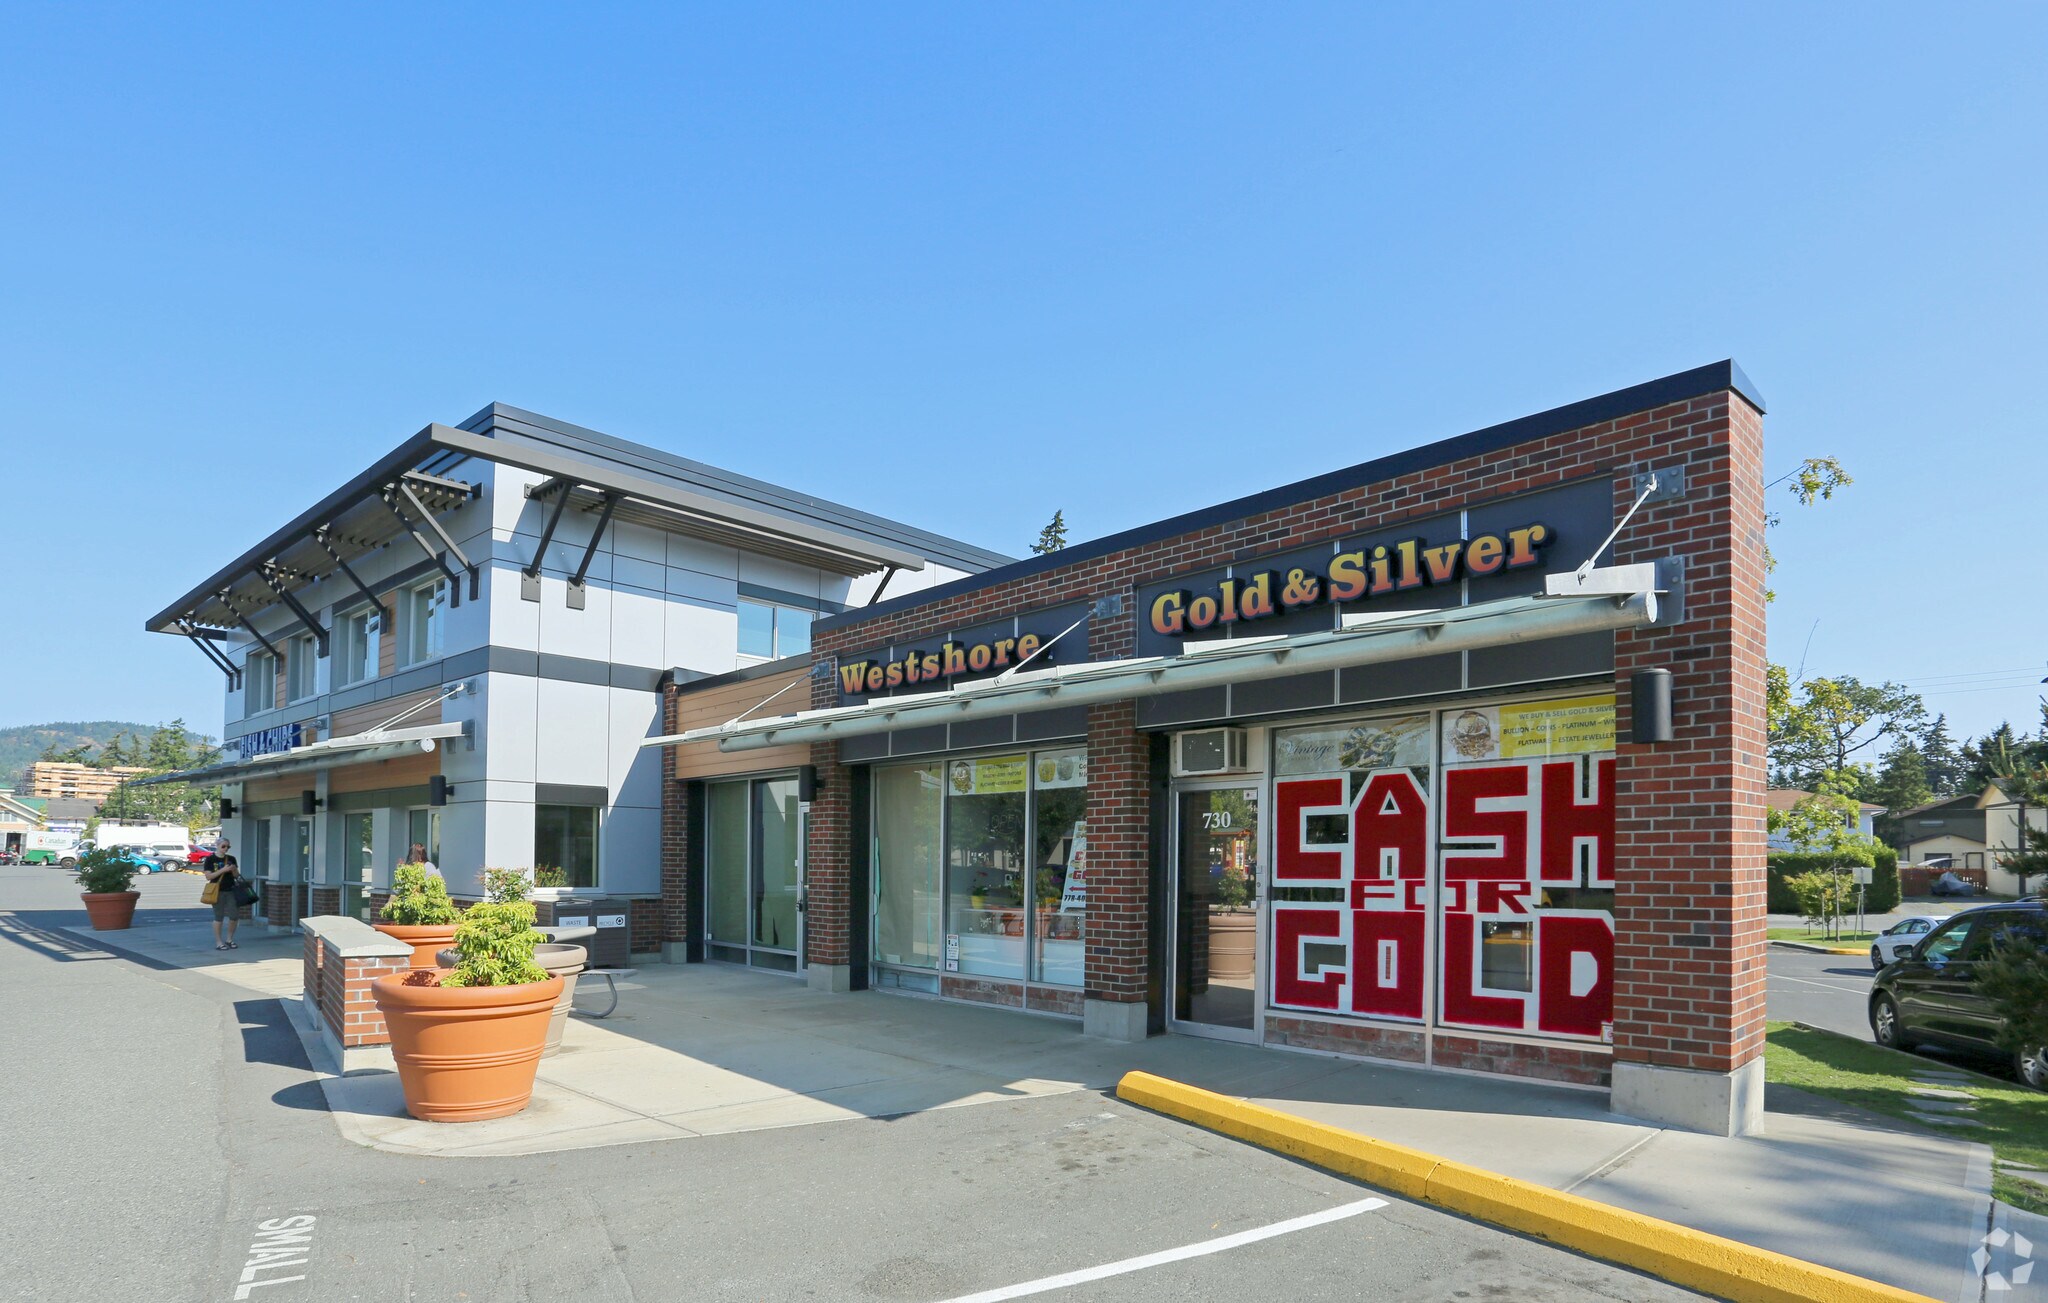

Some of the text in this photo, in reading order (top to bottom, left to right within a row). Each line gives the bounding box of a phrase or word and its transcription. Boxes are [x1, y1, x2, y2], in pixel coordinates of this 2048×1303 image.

[1150, 524, 1546, 635] Gold & Silver
[839, 633, 1040, 694] Westshore
[1503, 726, 1530, 735] BULLION
[1562, 720, 1597, 729] PLATINUM
[1530, 711, 1544, 719] BUY
[1568, 707, 1588, 715] GOLD
[241, 732, 258, 759] FISH
[266, 723, 294, 753] CHIPS
[1282, 739, 1335, 761] Vintage
[1518, 737, 1552, 746] FLATWARE
[1558, 735, 1580, 743] ESTATE
[1202, 811, 1232, 829] 730
[1276, 759, 1616, 881] CASH
[1350, 879, 1532, 914] FOR
[1275, 908, 1615, 1037] GOLD
[233, 1214, 317, 1301] SMALL
